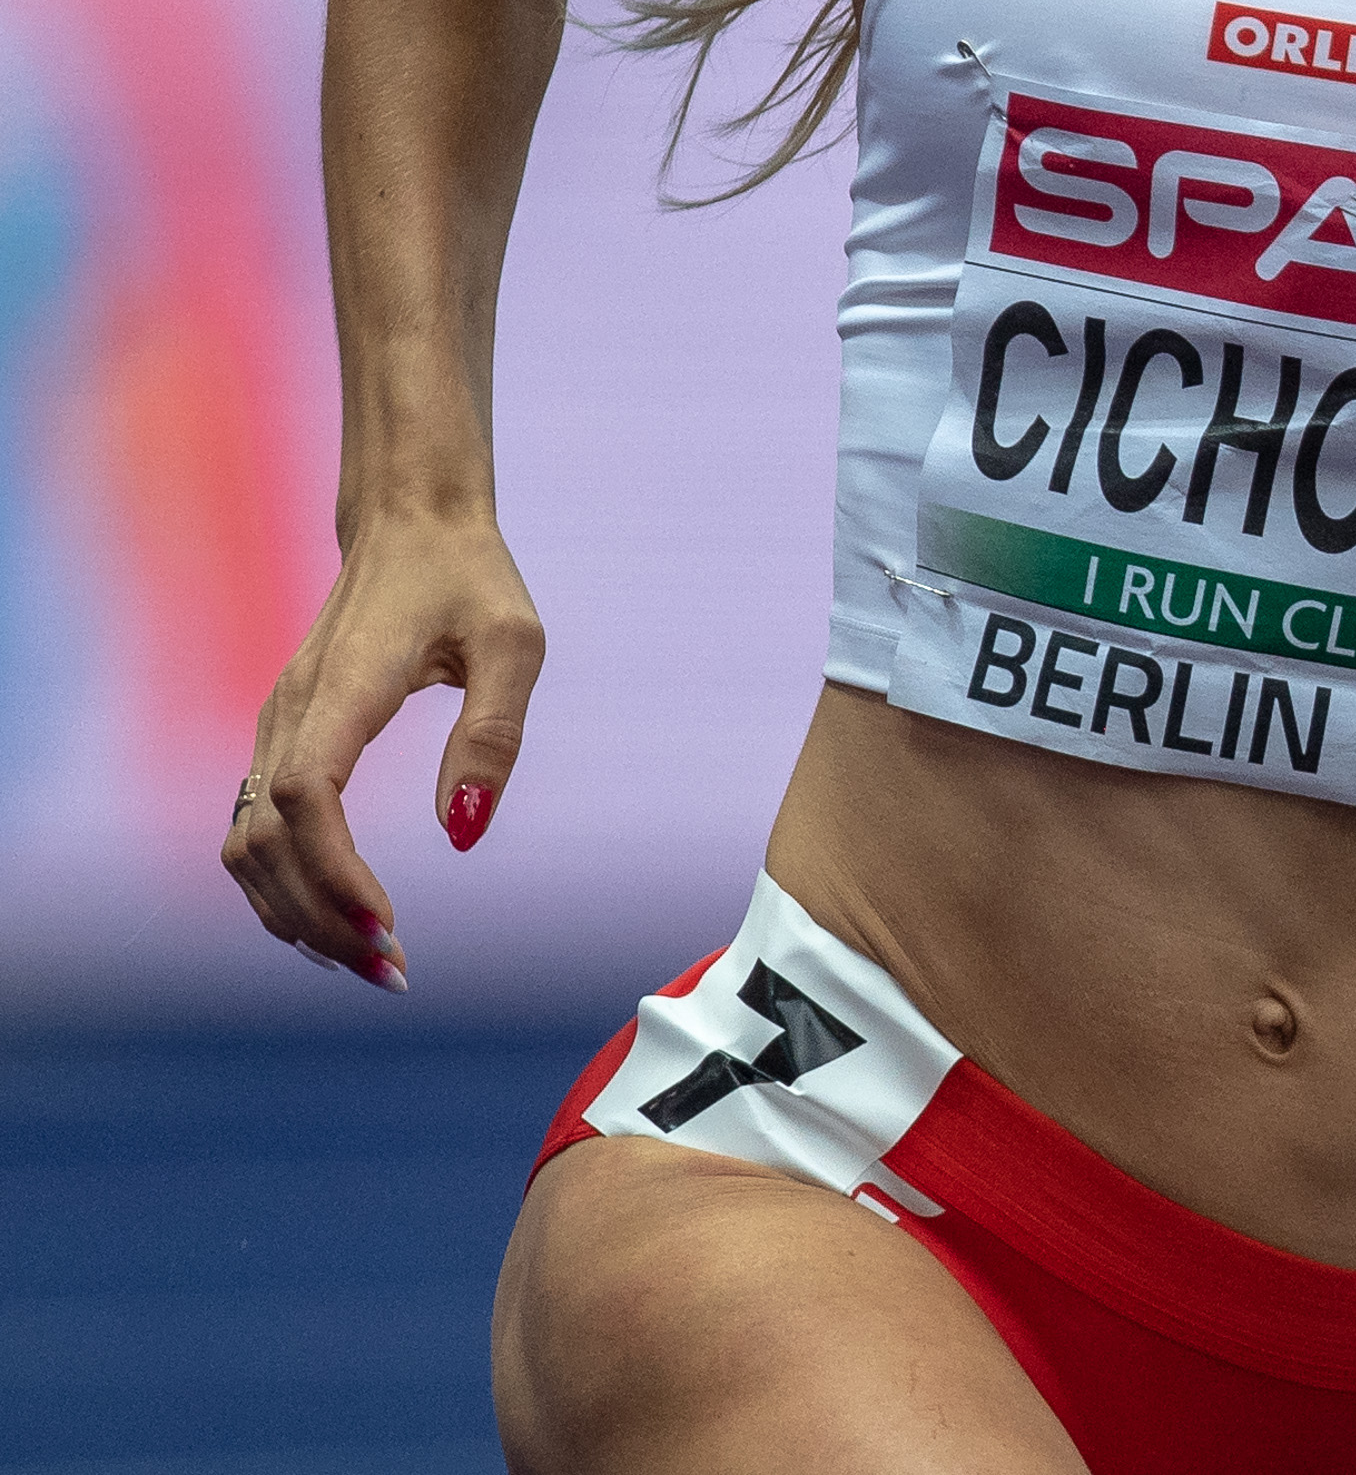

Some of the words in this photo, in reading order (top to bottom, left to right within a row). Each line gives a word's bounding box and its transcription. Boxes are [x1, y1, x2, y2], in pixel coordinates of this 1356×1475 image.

[1083, 556, 1099, 605] I
[1119, 563, 1259, 639] RUN
[966, 612, 1332, 775] BERLIN
[637, 957, 867, 1134] 7
